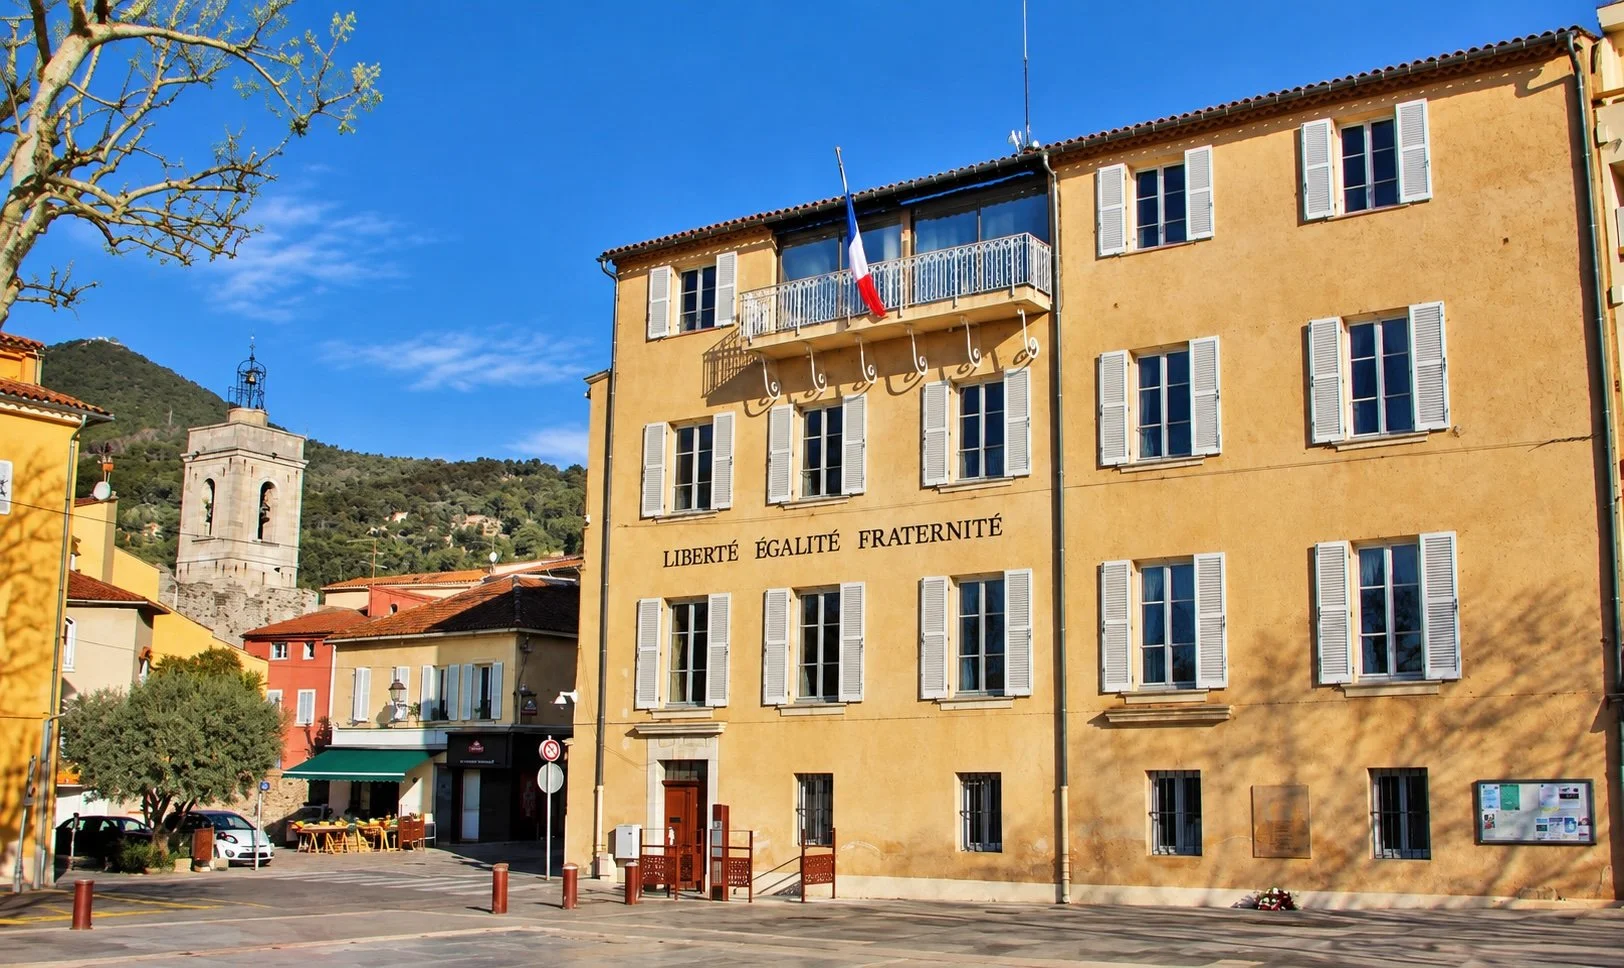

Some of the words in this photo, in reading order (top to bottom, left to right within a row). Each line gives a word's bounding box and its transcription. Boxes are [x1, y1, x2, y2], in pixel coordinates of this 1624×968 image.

[663, 539, 739, 568] LIBERTÉ
[755, 529, 841, 560] ÉGALITÉ
[858, 513, 1003, 549] FRATERNITÉ
